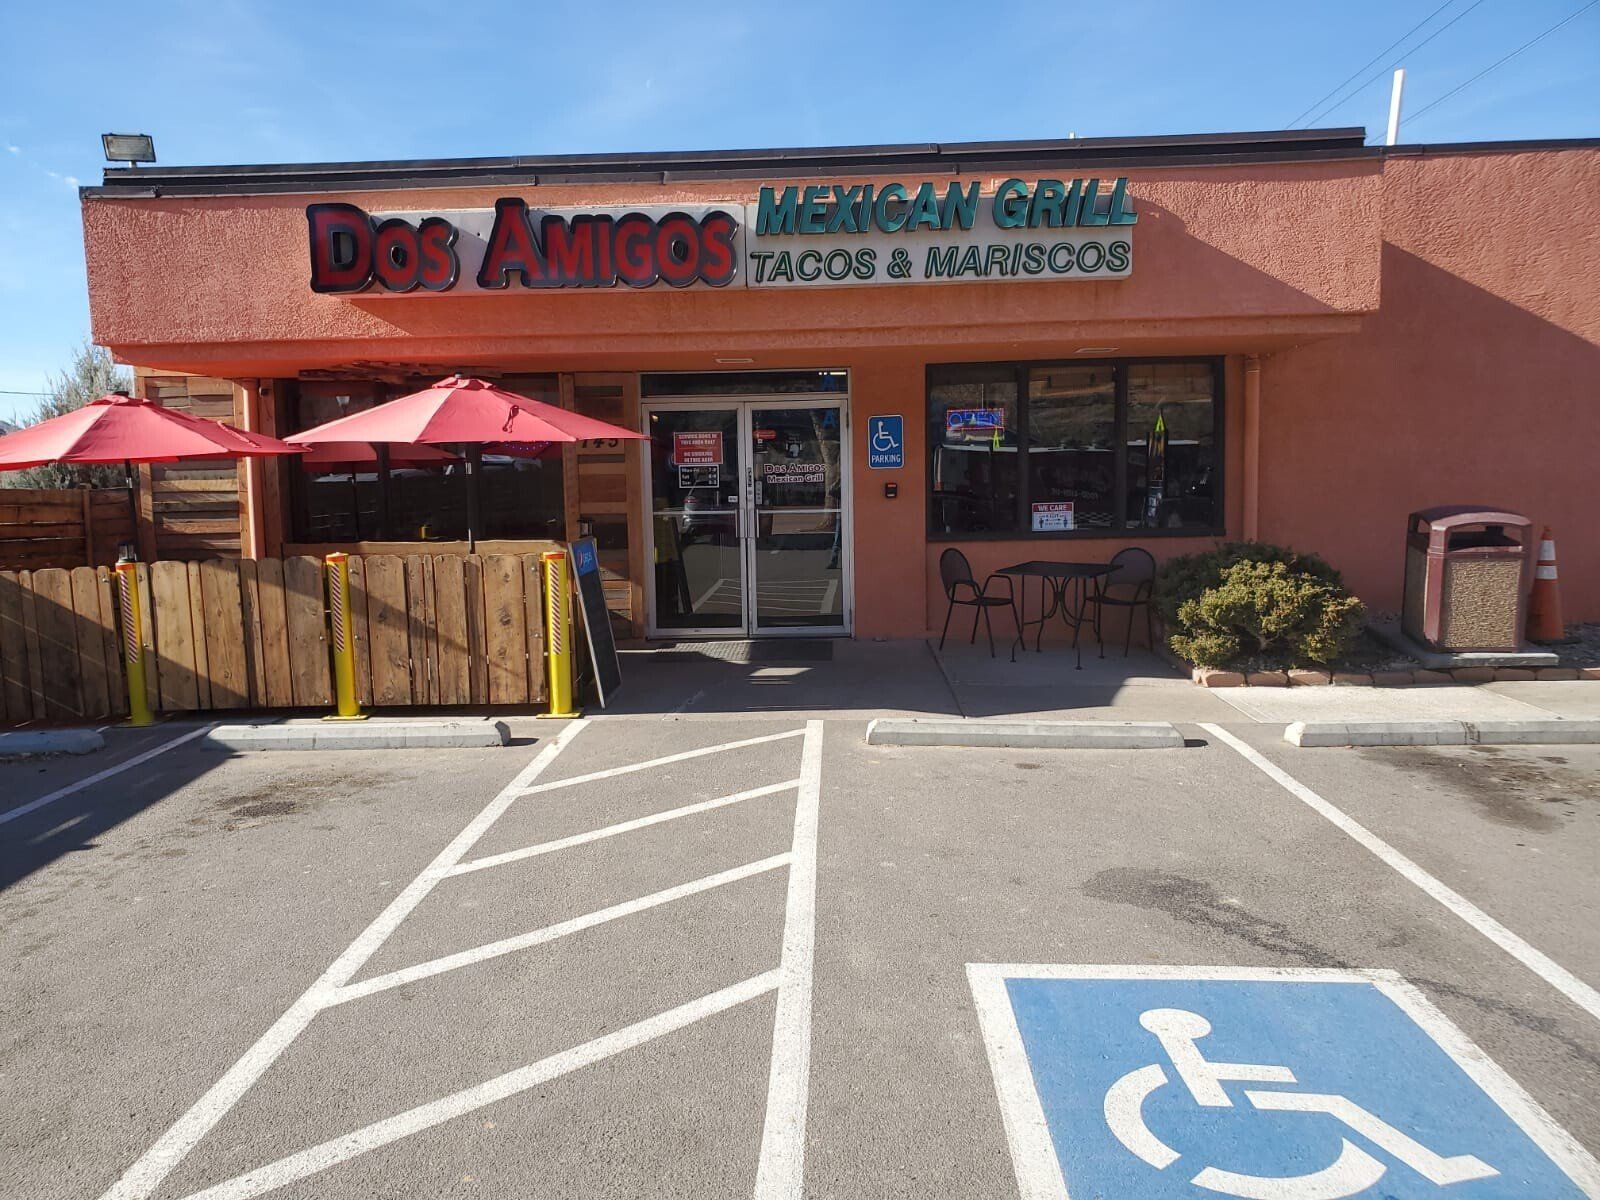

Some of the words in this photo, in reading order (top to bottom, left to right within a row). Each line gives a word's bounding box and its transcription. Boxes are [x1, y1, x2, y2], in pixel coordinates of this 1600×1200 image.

[756, 182, 981, 236] MEXICAN
[992, 177, 1138, 229] GRILL
[477, 197, 739, 288] AMIGOS
[750, 249, 876, 283] TACOS
[886, 248, 912, 279] &
[924, 241, 1130, 279] MARISCOS
[871, 455, 901, 463] PARKING
[767, 474, 804, 483] Mexican
[804, 472, 824, 482] Grill
[1049, 503, 1068, 511] CARE
